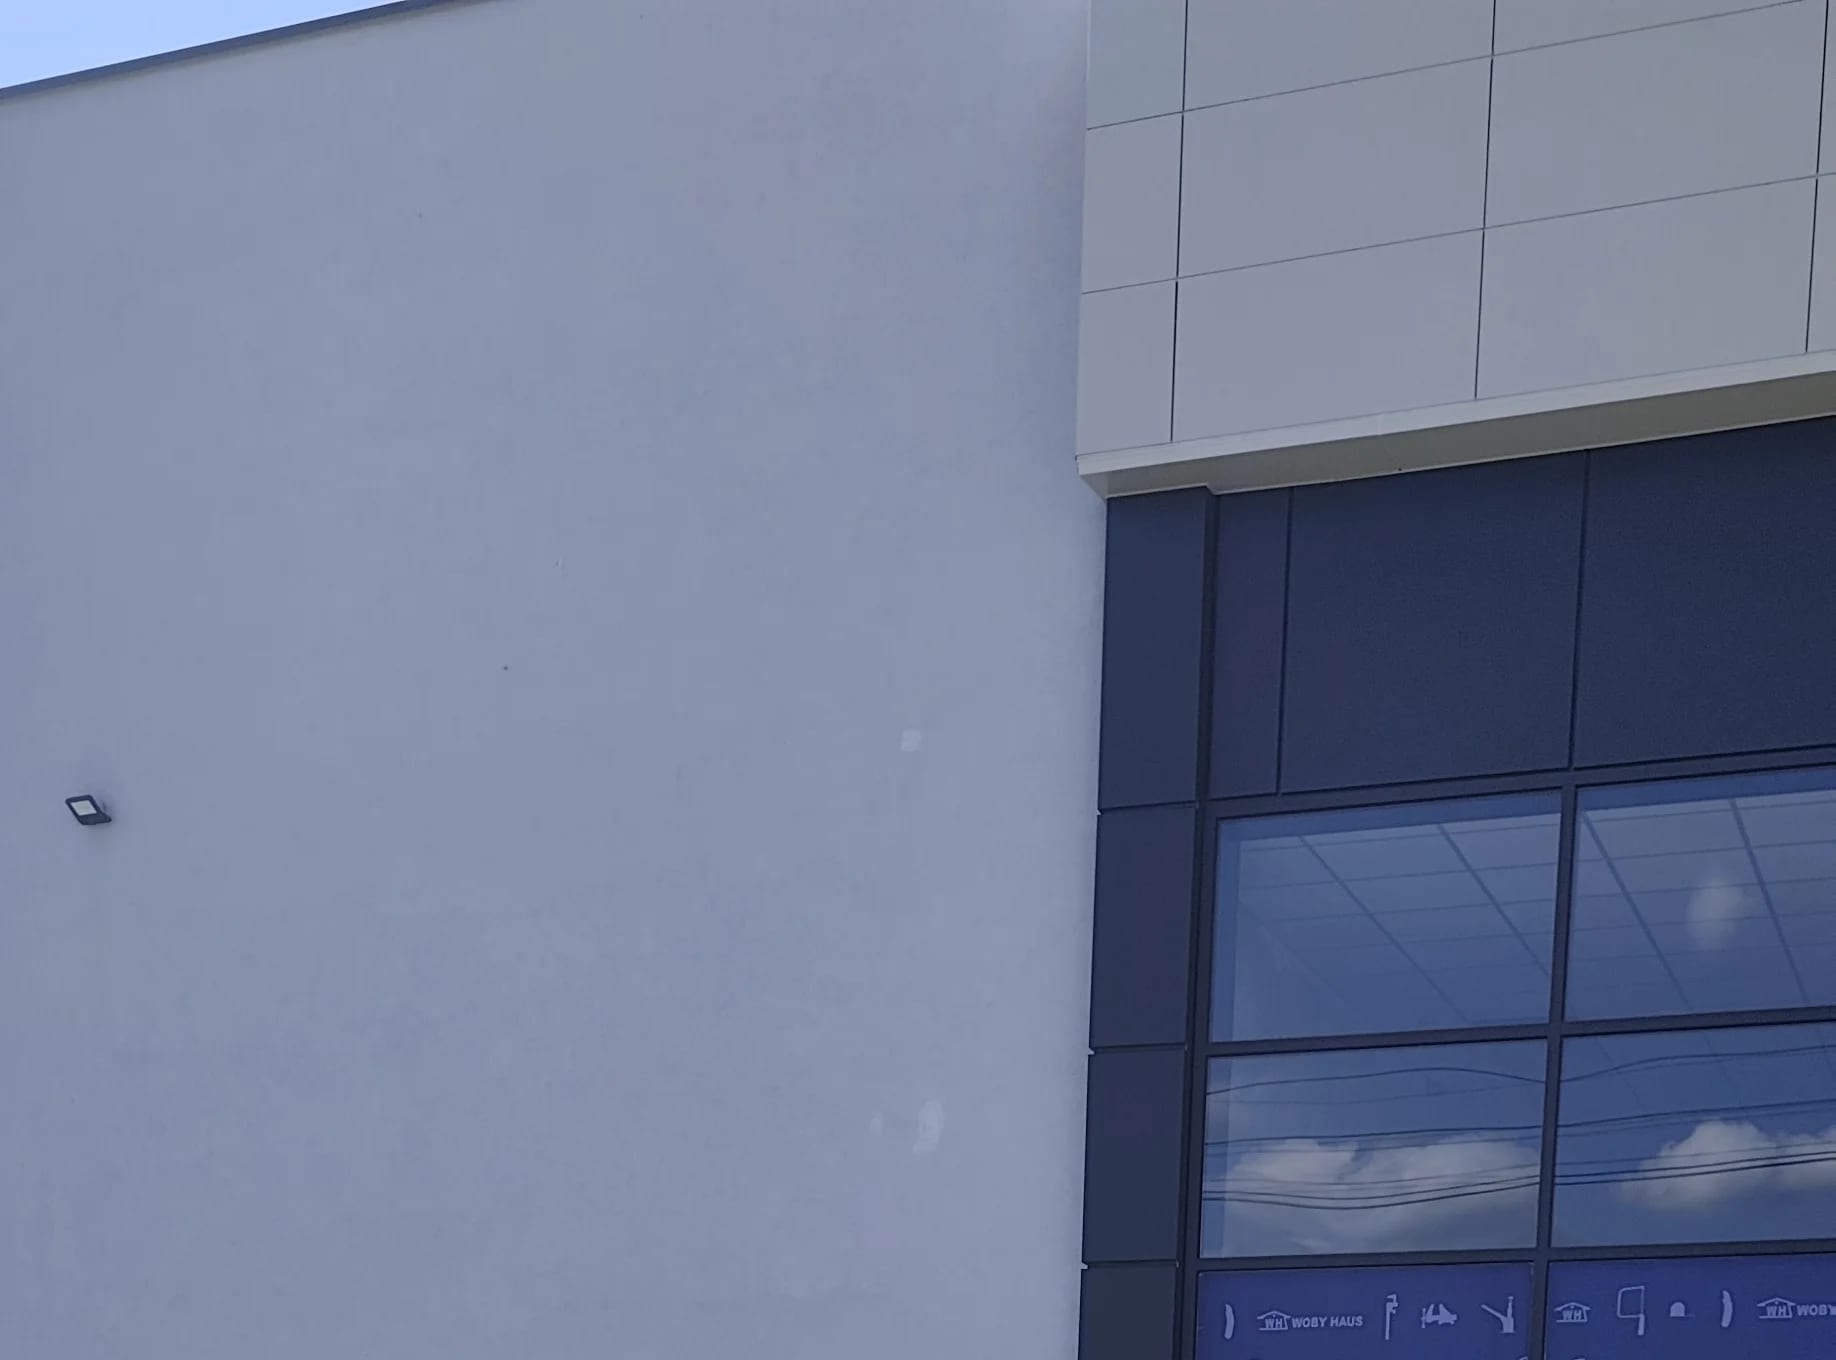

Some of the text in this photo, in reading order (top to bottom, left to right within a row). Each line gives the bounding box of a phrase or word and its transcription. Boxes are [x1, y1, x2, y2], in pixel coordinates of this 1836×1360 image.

[1562, 1310, 1581, 1320] WH
[1291, 1317, 1326, 1328] WOBY
[1330, 1316, 1363, 1327] HAUS
